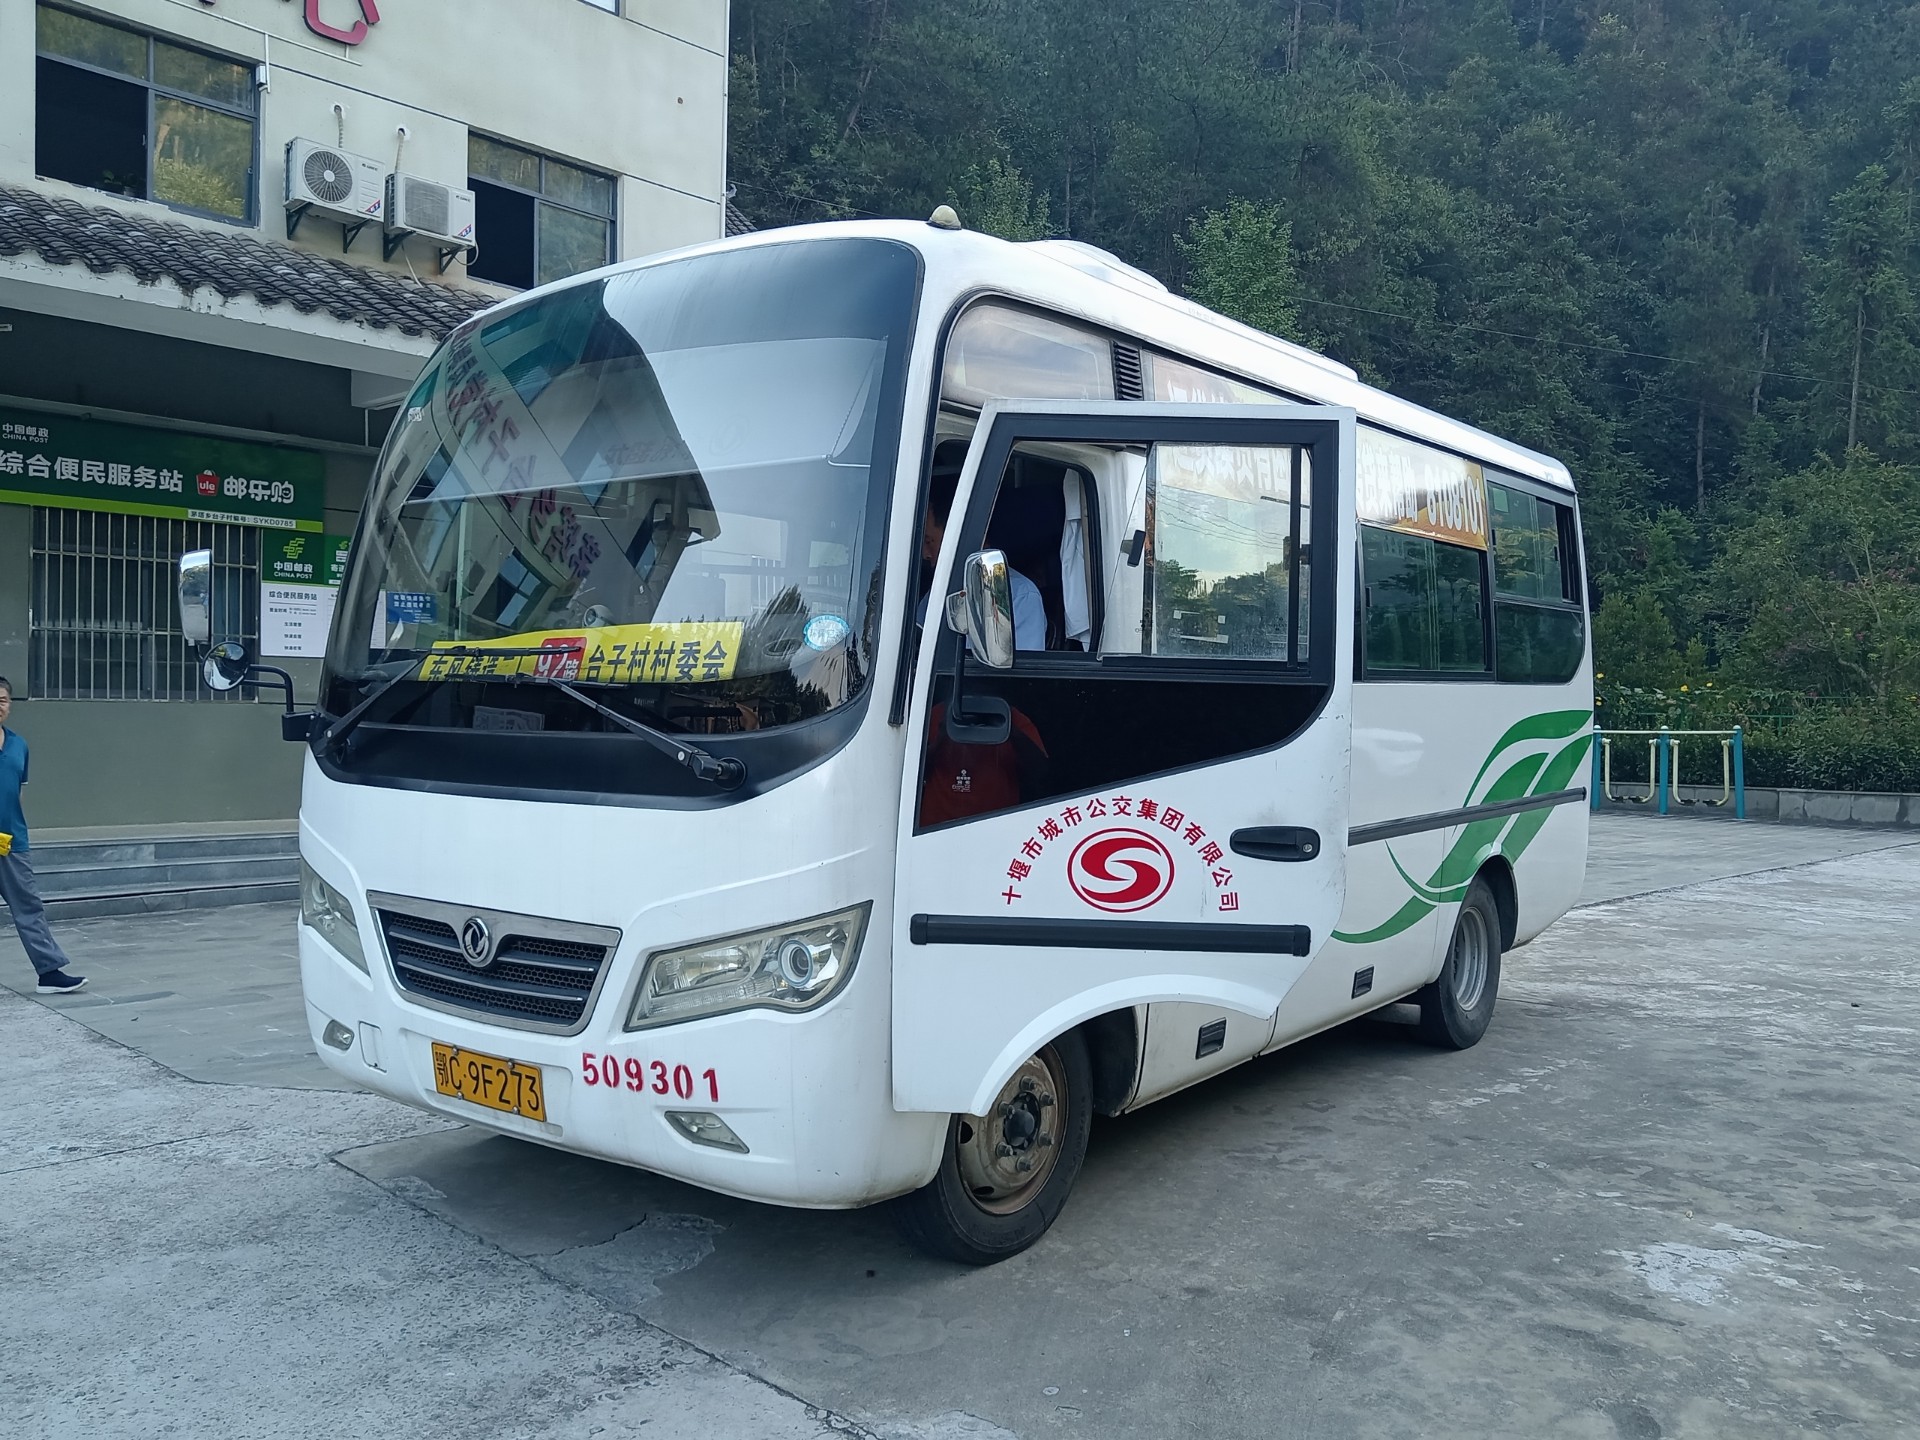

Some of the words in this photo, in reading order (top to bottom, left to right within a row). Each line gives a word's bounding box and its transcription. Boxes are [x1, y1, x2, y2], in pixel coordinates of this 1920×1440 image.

[2, 422, 49, 438] 中国邮政
[2, 433, 28, 442] CHINA
[29, 436, 49, 444] POST
[0, 450, 184, 493] 综合便民服务站
[199, 481, 216, 491] ule
[223, 475, 294, 504] 邮乐购
[273, 561, 313, 573] 中国邮政
[269, 590, 317, 600] 综合便民服务站
[534, 643, 581, 681] 92路
[587, 640, 728, 683] 台子村村委会
[1001, 795, 1240, 913] 十堰市城市公交集团有限公司
[581, 1052, 720, 1103] 509301
